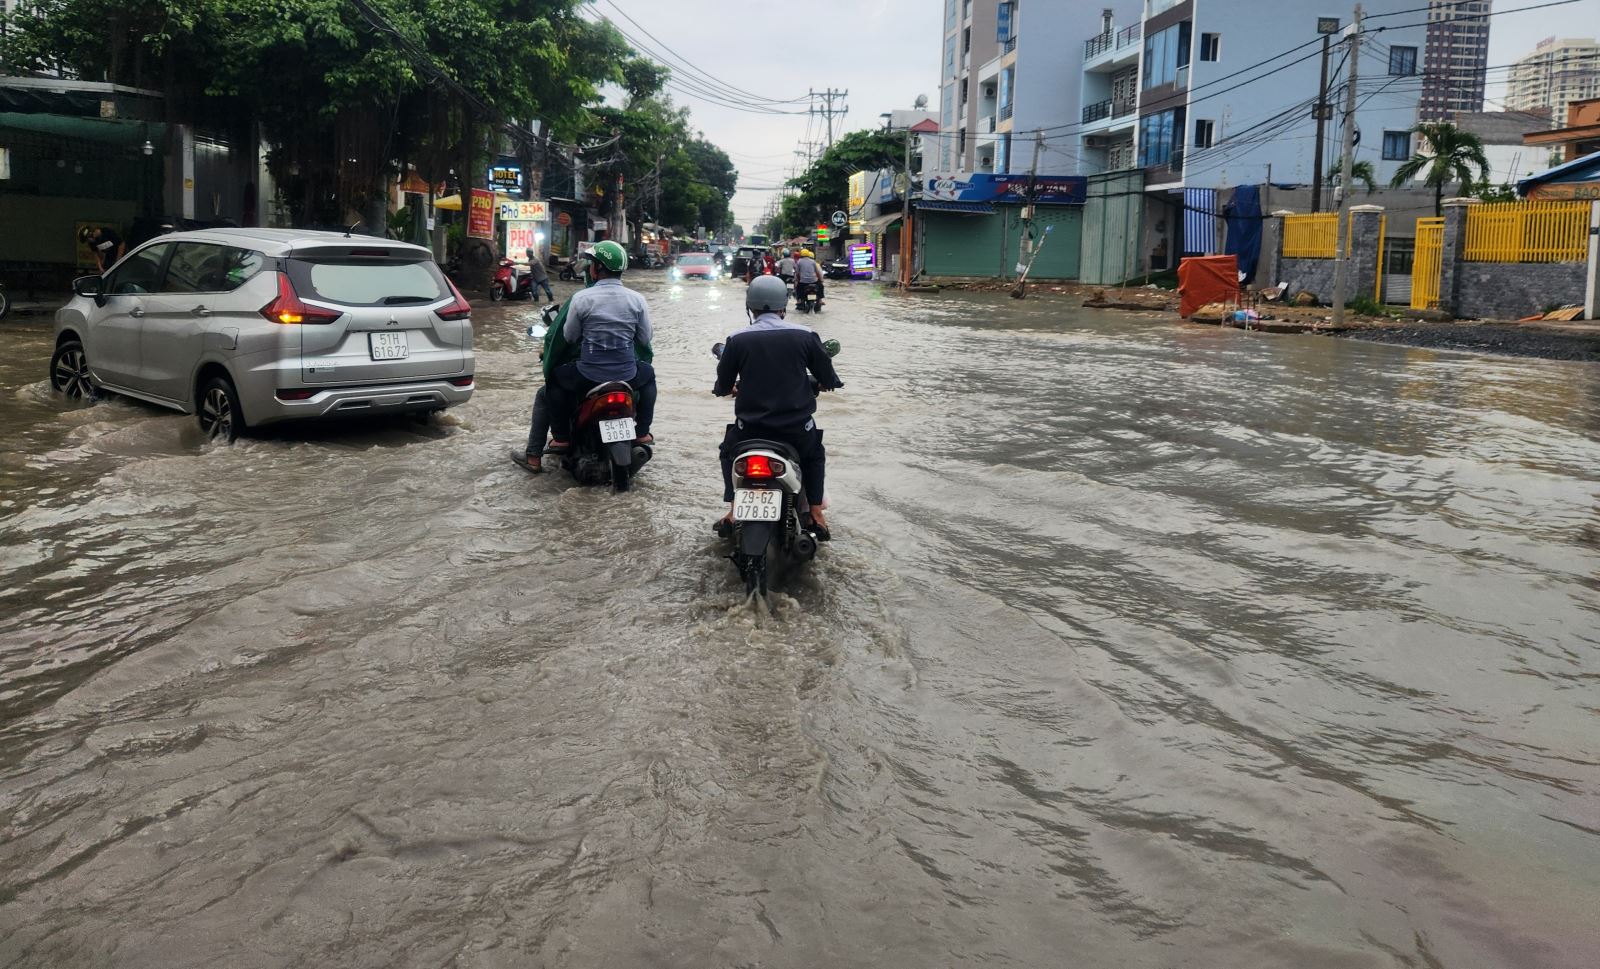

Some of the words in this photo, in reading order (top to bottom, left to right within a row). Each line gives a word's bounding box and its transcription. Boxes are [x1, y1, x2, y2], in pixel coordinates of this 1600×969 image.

[493, 171, 517, 179] HOTEL
[380, 334, 400, 346] 51H
[742, 491, 774, 504] 29-G2
[737, 505, 777, 519] 078.63
